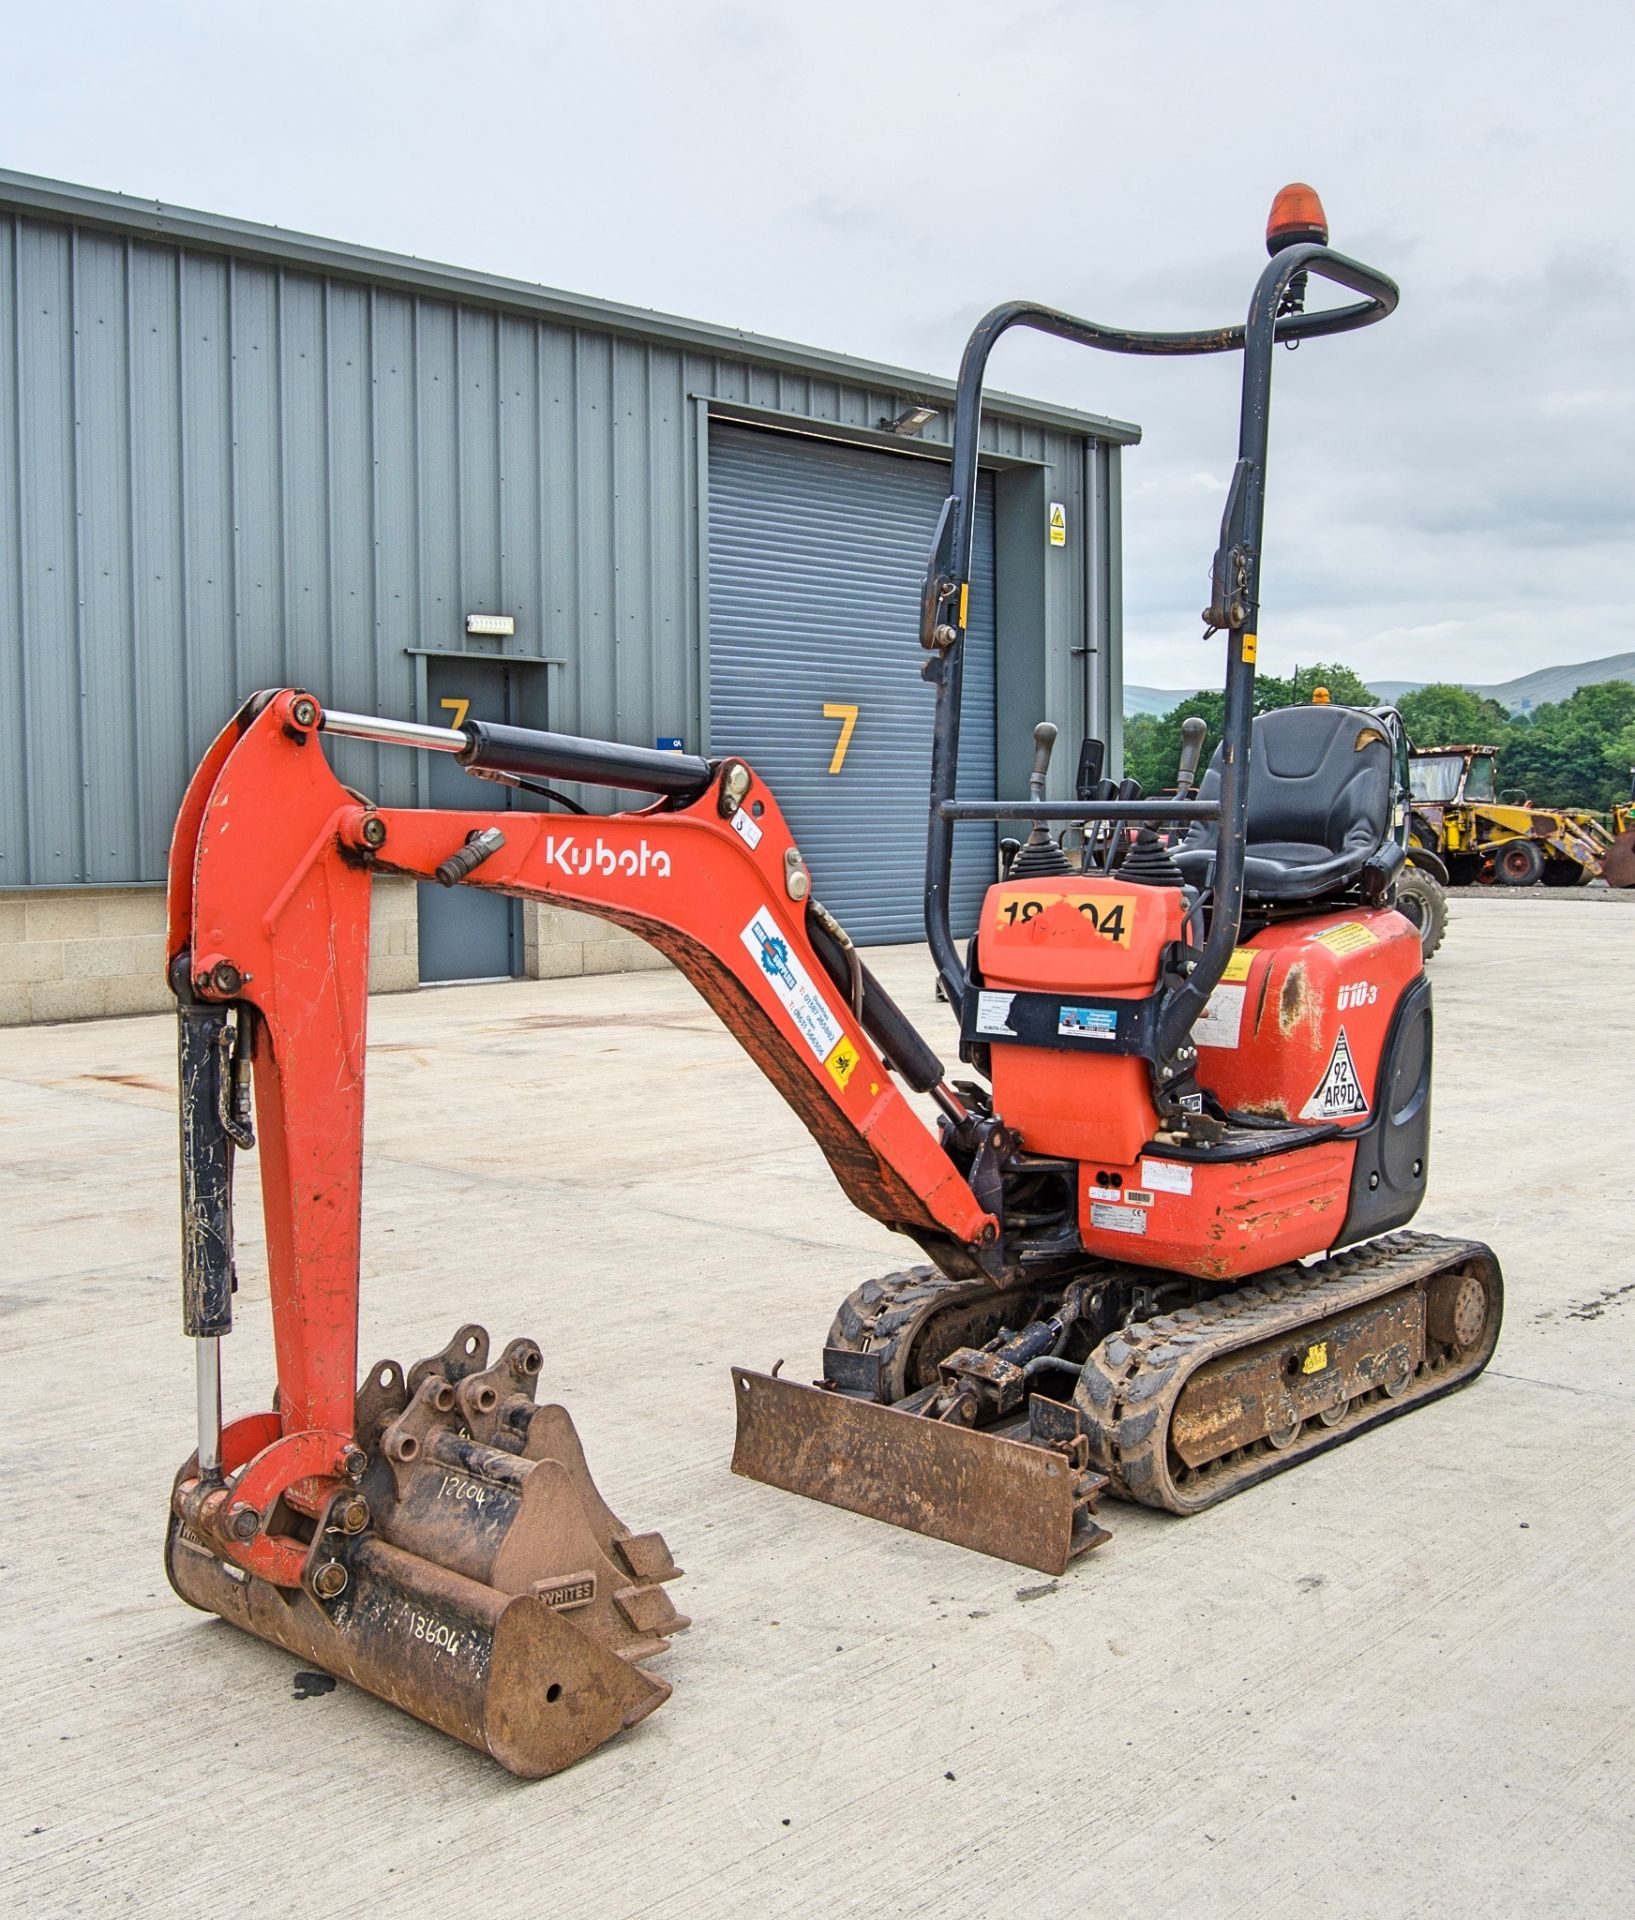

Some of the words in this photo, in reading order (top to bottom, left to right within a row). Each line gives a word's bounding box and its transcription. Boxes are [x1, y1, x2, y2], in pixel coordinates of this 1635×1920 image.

[441, 698, 469, 730] 7
[823, 703, 859, 774] 7
[546, 836, 671, 877] Kubota
[753, 923, 768, 943] HIRE
[772, 953, 796, 989] SUPPLIES
[803, 993, 819, 1016] 01387
[1334, 1061, 1347, 1084] 92
[437, 1476, 486, 1510] 18604
[409, 1612, 460, 1657] 18604
